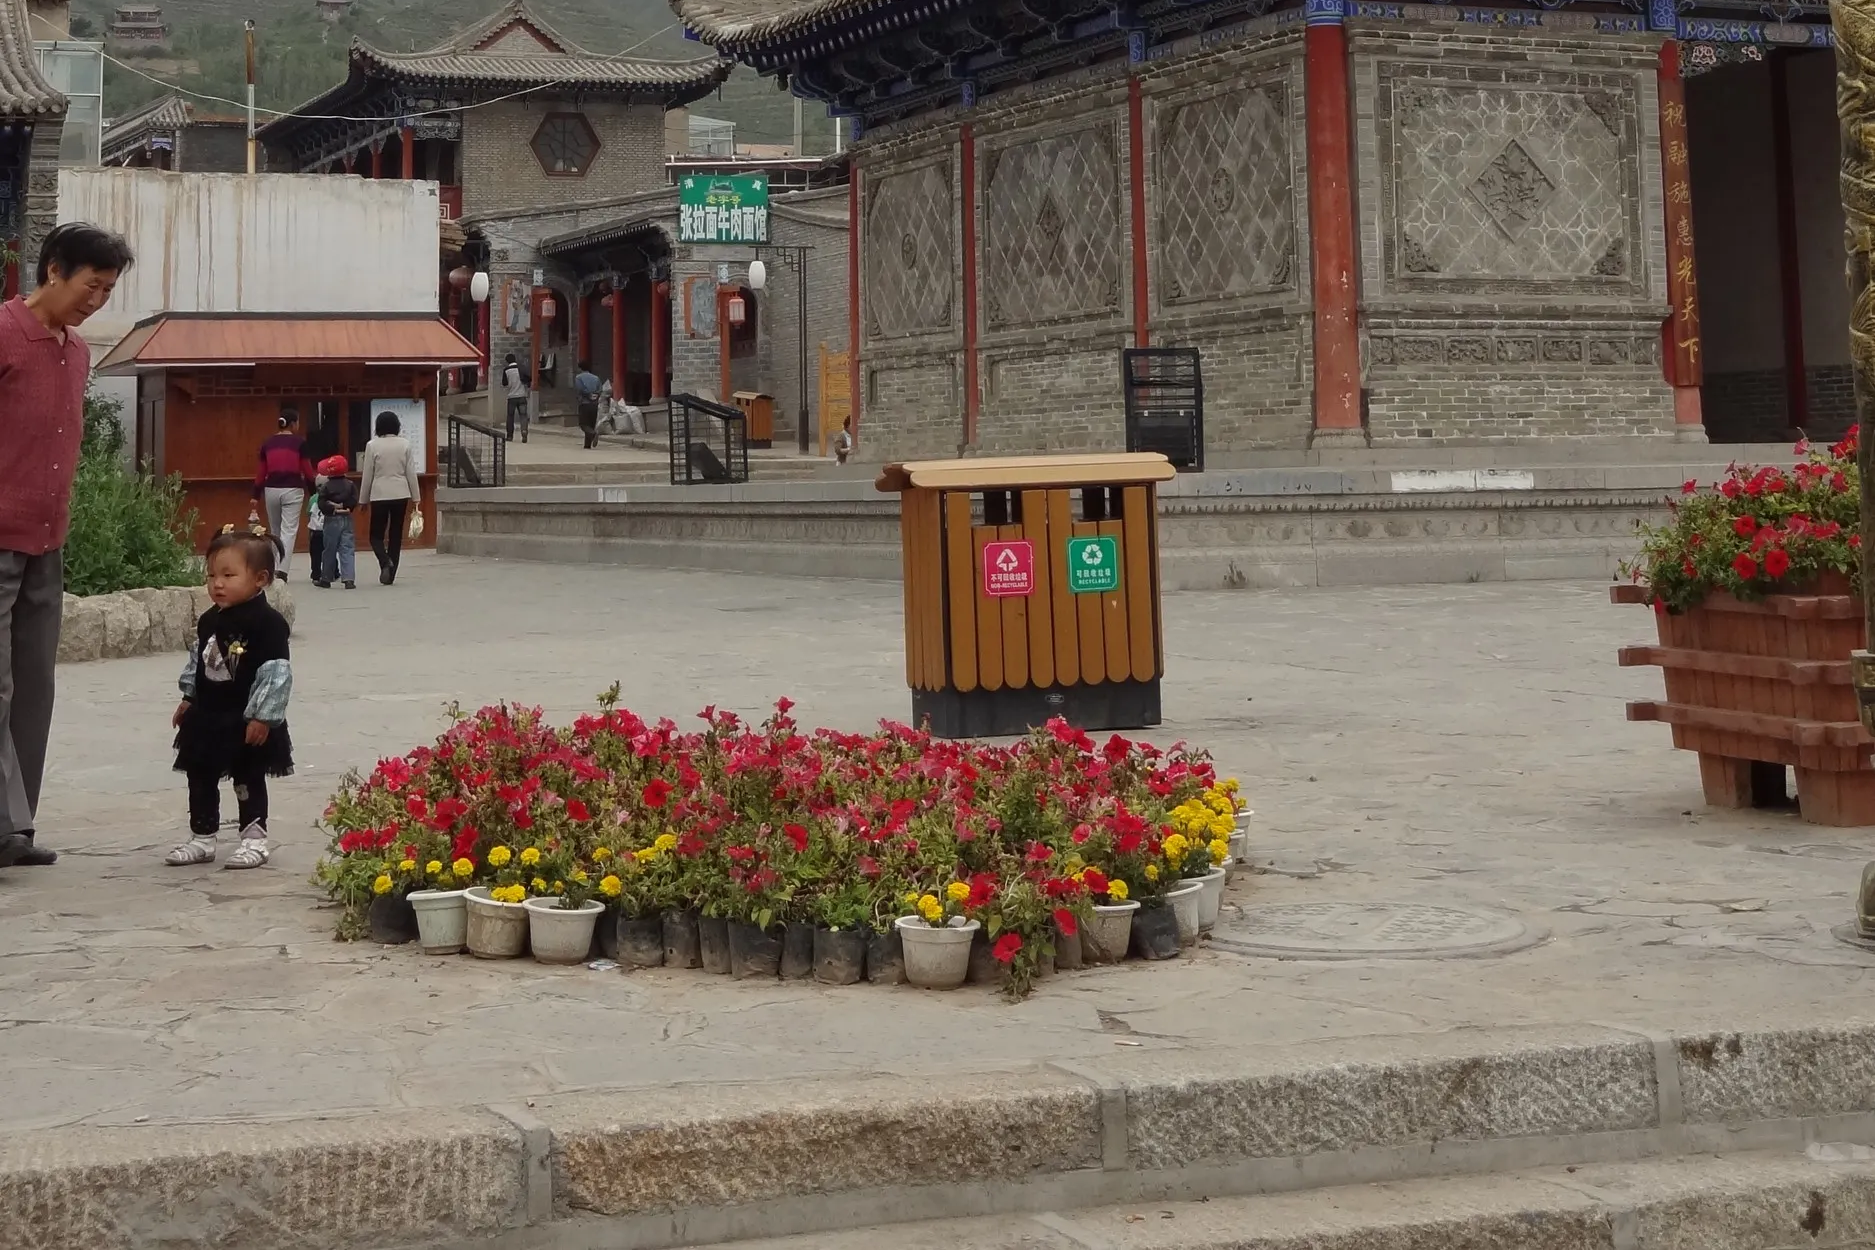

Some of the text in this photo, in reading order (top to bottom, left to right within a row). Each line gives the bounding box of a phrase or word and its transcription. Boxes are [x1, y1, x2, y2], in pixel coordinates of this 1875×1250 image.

[706, 194, 741, 204] 老字号
[680, 203, 767, 241] 张拉面牛肉面馆
[990, 572, 1028, 582] 不可回收垃圾
[1076, 568, 1111, 579] 可回收垃圾
[1078, 577, 1111, 585] RECYCLABLE
